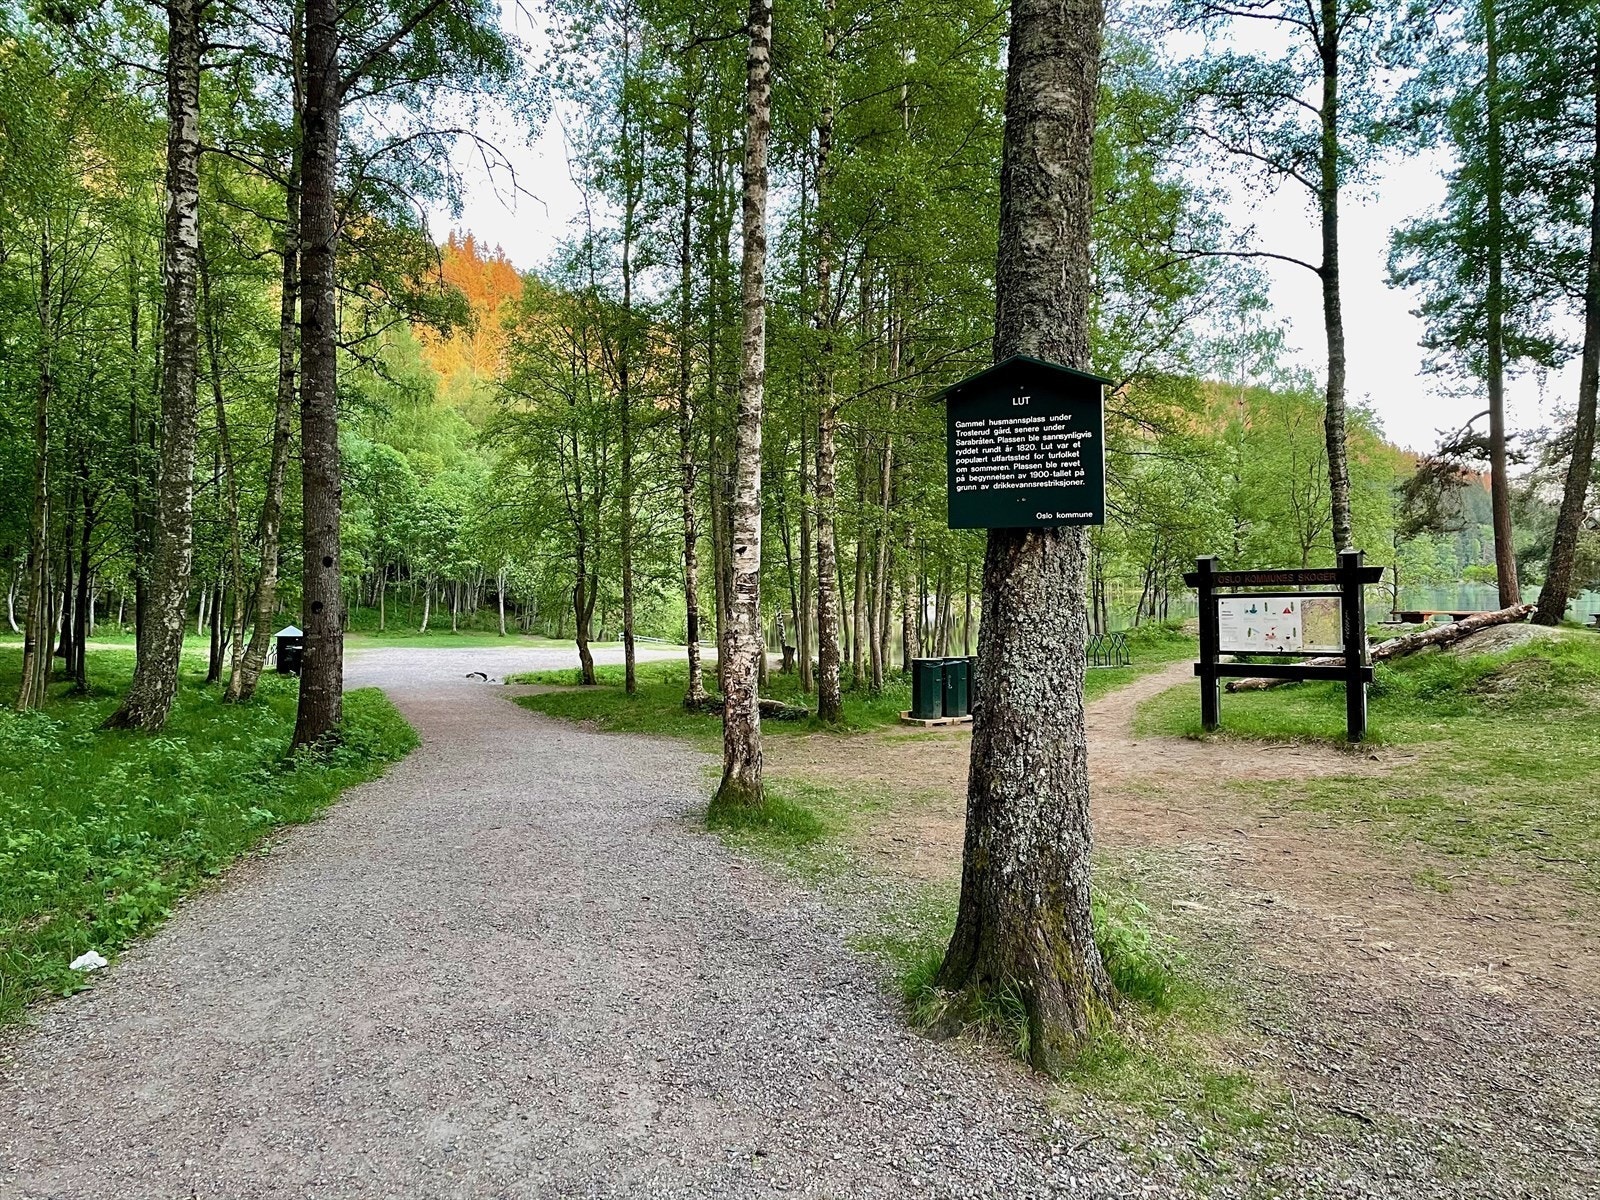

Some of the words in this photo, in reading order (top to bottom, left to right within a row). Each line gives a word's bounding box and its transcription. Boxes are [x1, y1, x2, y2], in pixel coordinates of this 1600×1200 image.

[1012, 396, 1030, 406] LUT
[956, 420, 985, 428] Gammel
[989, 416, 1045, 425] husmannsplass
[956, 429, 990, 437] Trosterud
[1015, 425, 1039, 433] senere
[998, 435, 1025, 443] Plassen
[1043, 431, 1092, 441] sannsynligvis
[956, 447, 978, 456] ryddet
[1005, 444, 1012, 452] år
[956, 455, 988, 465] populært
[992, 454, 1030, 462] utfartssted
[1034, 452, 1044, 460] for
[1048, 451, 1079, 459] turfolket
[971, 464, 1010, 472] sommeren.
[1013, 462, 1042, 470] Plassen
[956, 475, 965, 483] på
[969, 473, 1015, 482] begynnelsen
[1030, 470, 1071, 478] 1900-tallet
[1075, 468, 1085, 477] på
[956, 484, 977, 492] grunn
[993, 480, 1085, 489] drikkevannsrestriksjoner.
[1056, 511, 1093, 519] kommune
[1218, 575, 1241, 584] OSLO
[1245, 573, 1294, 583] KOMMUNES
[1298, 572, 1336, 581] SKOGER
